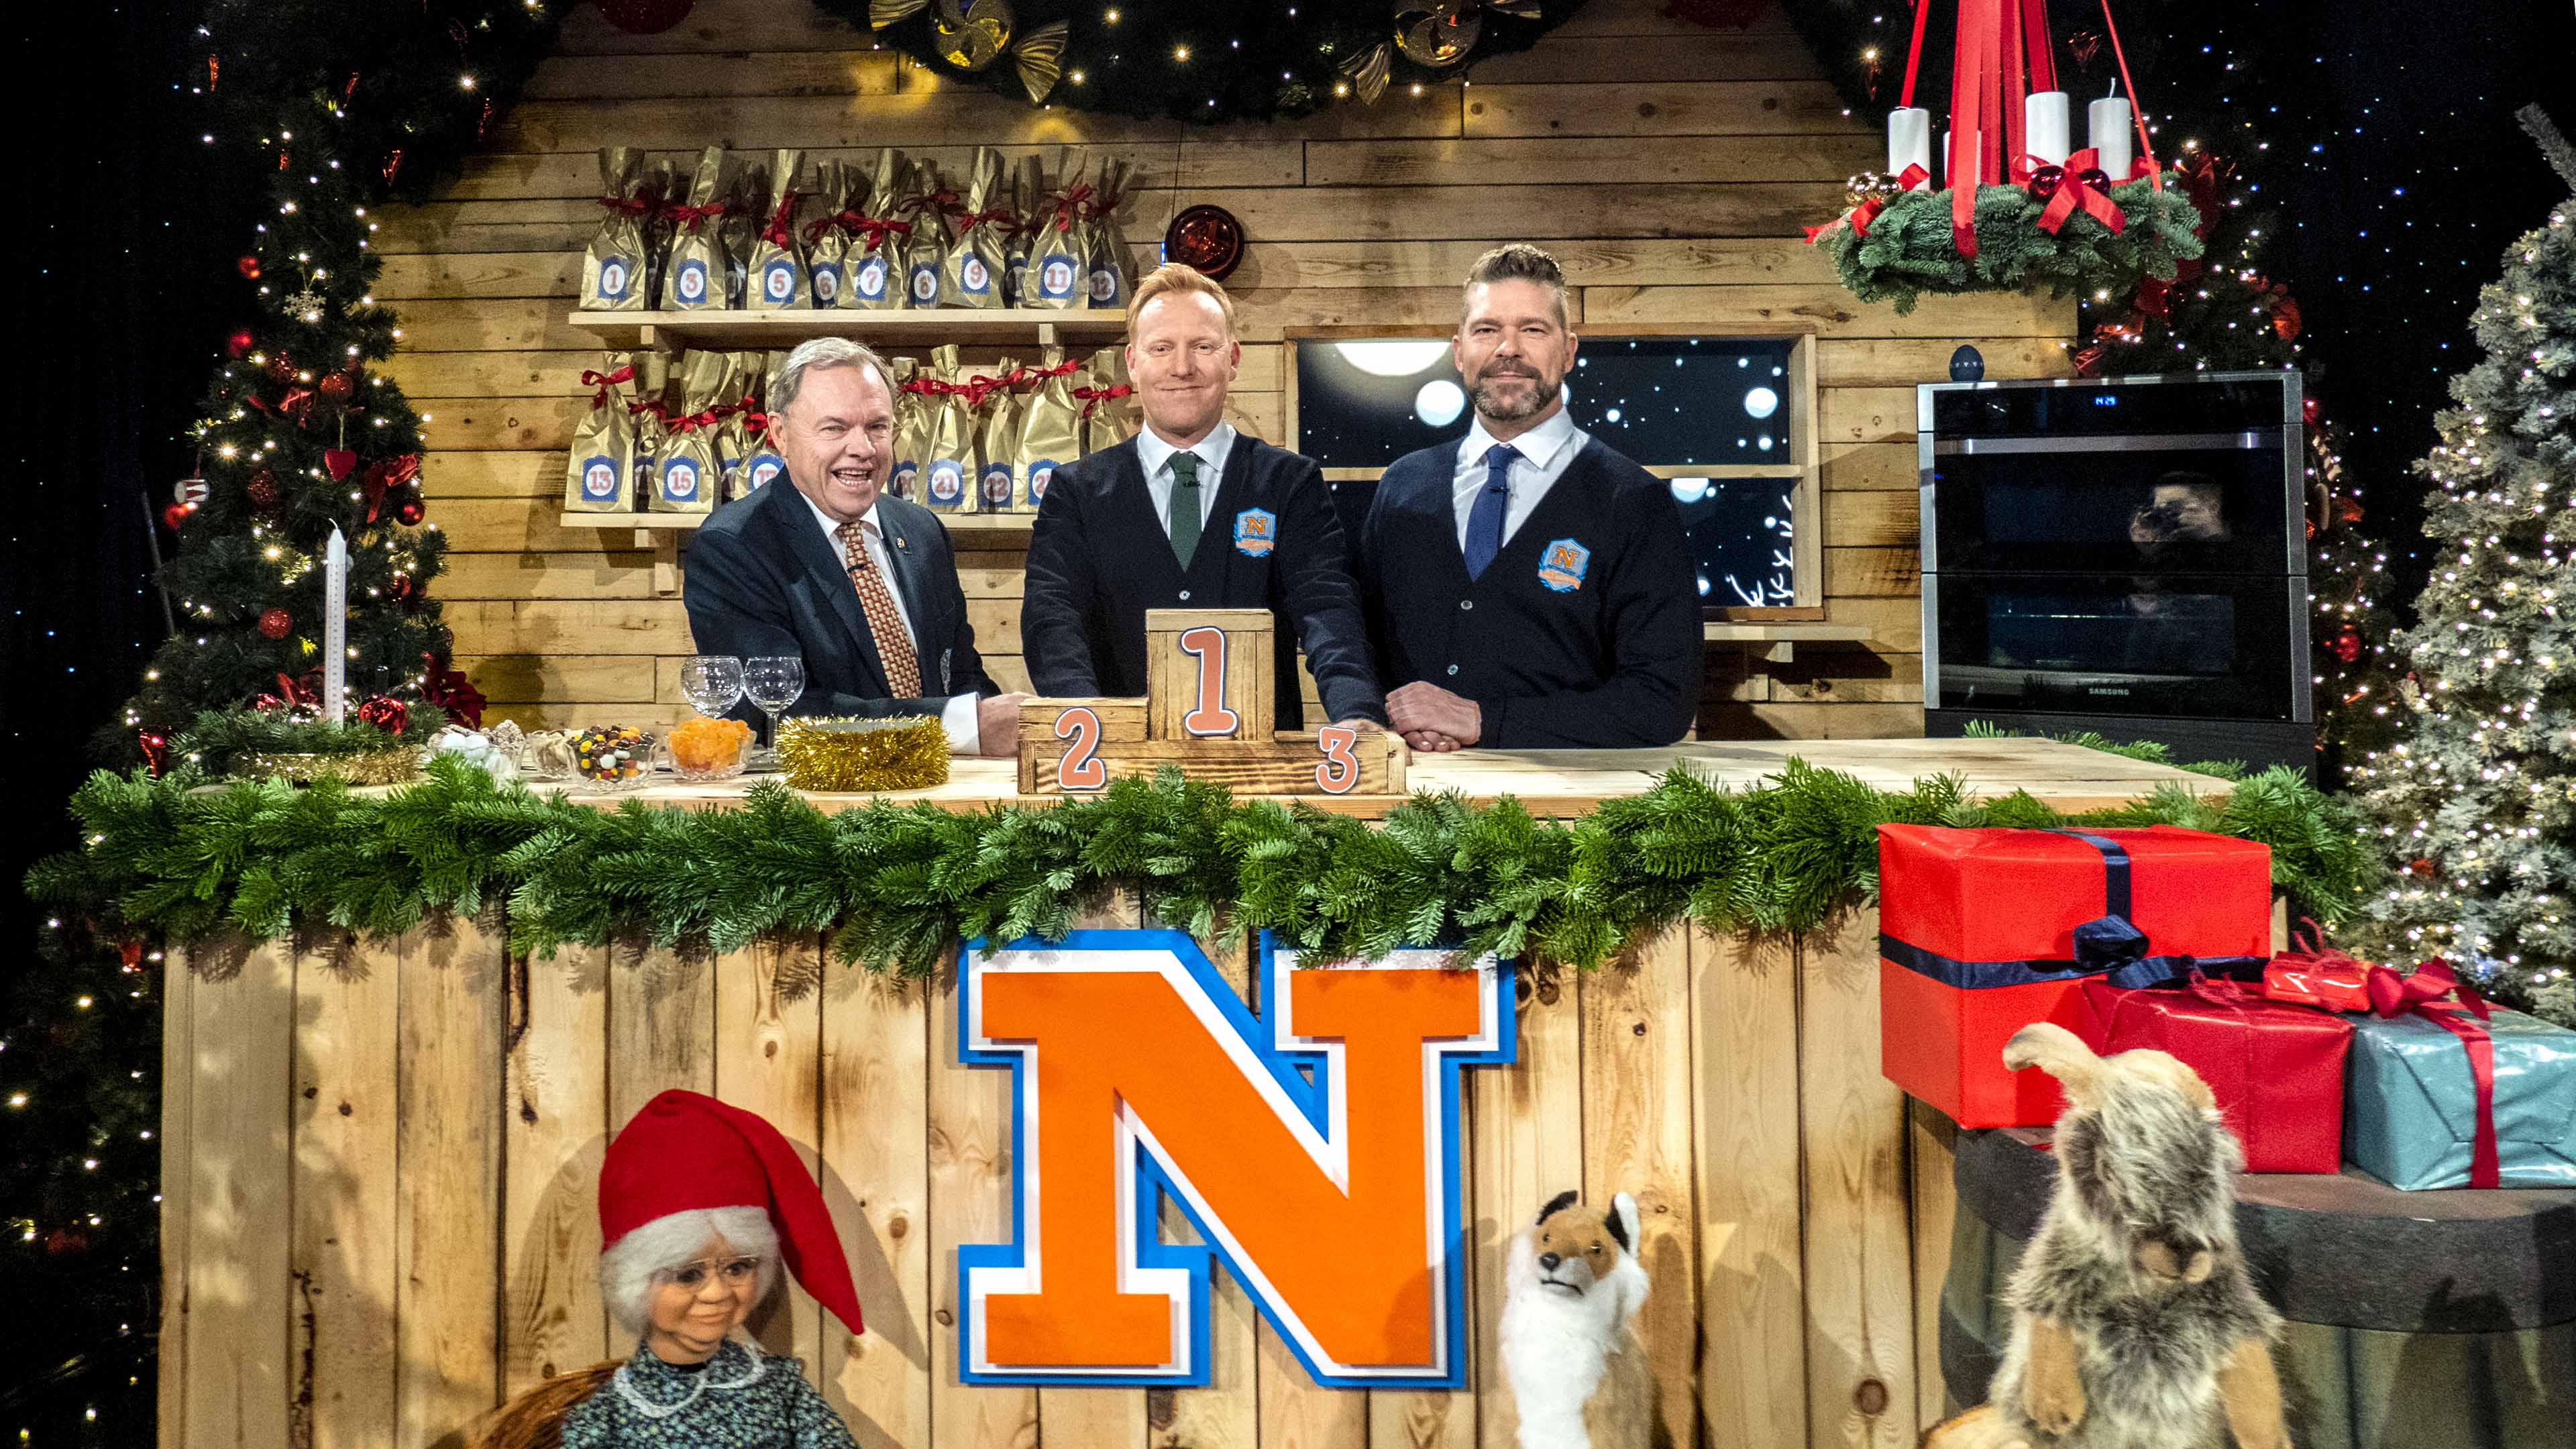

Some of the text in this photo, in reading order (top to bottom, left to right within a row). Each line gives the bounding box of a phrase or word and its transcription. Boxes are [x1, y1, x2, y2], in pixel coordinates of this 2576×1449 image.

[608, 269, 619, 290] 1
[686, 272, 698, 293] 3
[773, 273, 786, 292] 5
[865, 270, 878, 290] 7
[969, 264, 983, 284] 9
[1046, 268, 1069, 288] 11
[1090, 276, 1112, 297] 12
[589, 470, 612, 491] 13
[671, 471, 693, 491] 15
[933, 474, 957, 494] 21
[985, 476, 1010, 496] 22
[1246, 516, 1267, 535] N
[1552, 547, 1579, 568] N
[1181, 627, 1238, 735] 1
[2088, 688, 2129, 696] SAMSUNG
[1055, 708, 1106, 789] 2
[1315, 726, 1359, 794] 3
[967, 947, 1501, 1378] N
